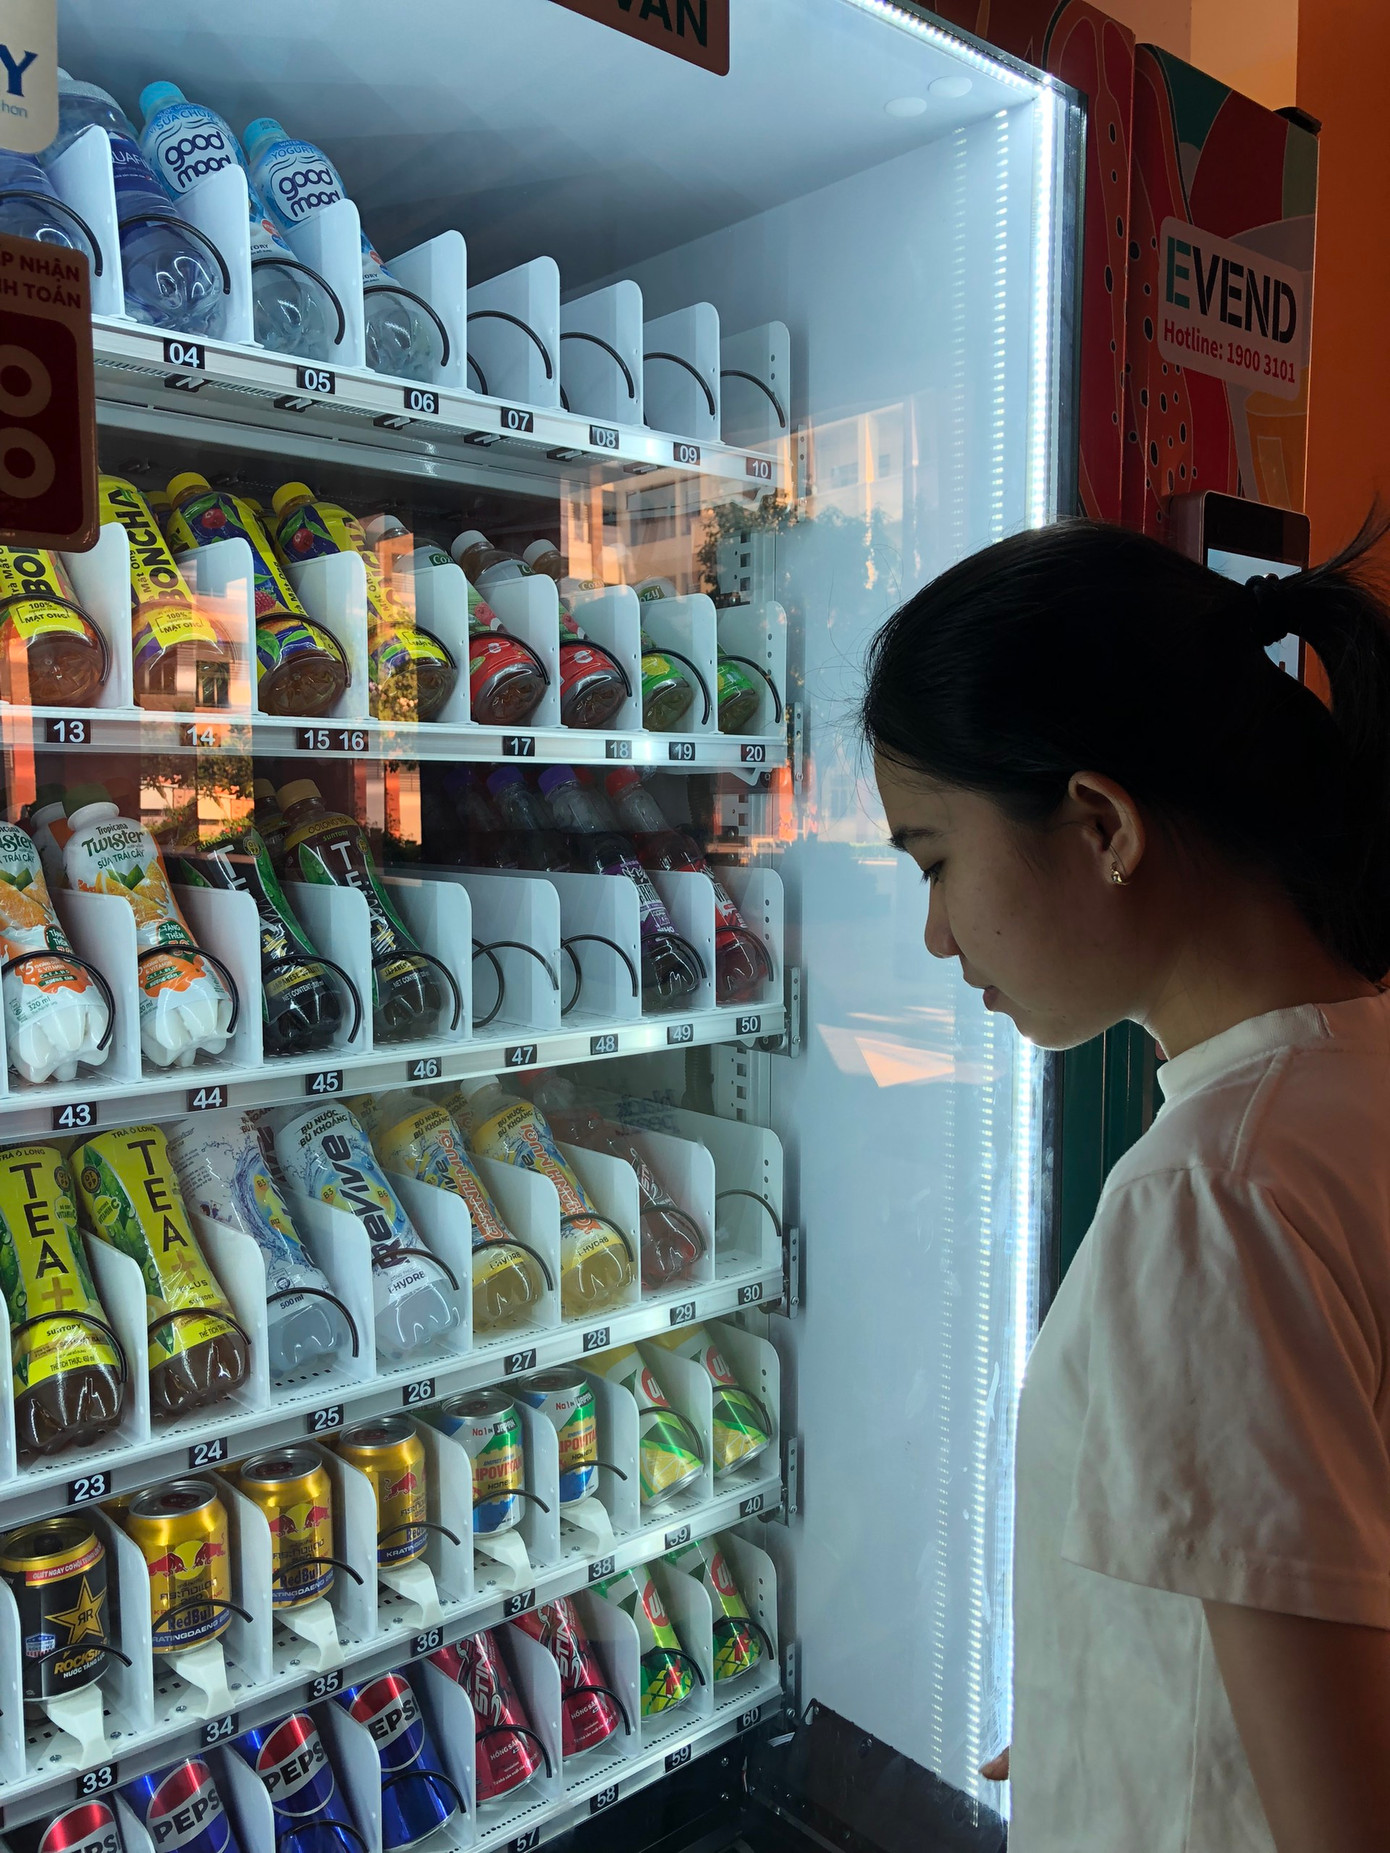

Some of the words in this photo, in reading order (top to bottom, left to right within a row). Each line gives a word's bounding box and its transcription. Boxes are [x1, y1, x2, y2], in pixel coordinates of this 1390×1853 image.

[165, 131, 225, 172] good
[272, 145, 315, 161] YOGURT
[278, 168, 333, 202] good
[1166, 235, 1297, 344] EVEND
[169, 342, 199, 368] 04
[1164, 318, 1224, 361] Hotline:
[1227, 342, 1260, 372] 1900
[1264, 354, 1296, 384] 3101
[305, 369, 330, 392] 05
[410, 391, 434, 413] 06
[508, 410, 530, 431] 07
[597, 430, 615, 447] 08
[680, 446, 697, 464] 09
[753, 461, 768, 477] 10
[28, 602, 52, 610] 100%
[166, 611, 188, 619] 100%
[54, 721, 85, 742] 13
[187, 726, 215, 746] 14
[305, 730, 330, 750] 15
[339, 731, 365, 751] 16
[511, 738, 532, 755] 17
[610, 741, 628, 758] 18
[675, 744, 692, 759] 19
[746, 746, 762, 761] 20
[96, 823, 129, 835] Tropicana
[25, 961, 34, 975] 5
[673, 1024, 691, 1041] 49
[741, 1016, 758, 1032] 50
[595, 1036, 615, 1053] 48
[511, 1047, 534, 1065] 47
[413, 1059, 437, 1078] 46
[312, 1072, 338, 1092] 45
[193, 1087, 222, 1108] 44
[59, 1105, 91, 1127] 43
[299, 1134, 313, 1147] BÙ
[314, 1114, 349, 1137] KHOÁNG
[301, 1121, 313, 1133] BÙ
[23, 1148, 46, 1157] LONG
[323, 1187, 334, 1200] B3
[377, 1189, 389, 1199] B6
[280, 1298, 295, 1310] 500
[295, 1294, 305, 1303] ml
[743, 1284, 760, 1301] 30
[676, 1303, 692, 1320] 29
[587, 1329, 606, 1348] 28
[512, 1351, 533, 1371] 27
[408, 1379, 431, 1402] 26
[314, 1405, 340, 1429] 25
[195, 1440, 222, 1465] 24
[74, 1475, 105, 1500] 23
[745, 1496, 761, 1514] 40
[670, 1527, 687, 1546] 39
[49, 1566, 64, 1577] NGAY
[593, 1558, 612, 1577] 38
[511, 1591, 532, 1612] 37
[417, 1629, 439, 1652] 36
[313, 1672, 339, 1696] 35
[743, 1707, 759, 1727] 60
[206, 1718, 234, 1742] 34
[672, 1746, 689, 1765] 59
[83, 1766, 113, 1793] 33
[597, 1786, 616, 1808] 58
[516, 1832, 536, 1851] 57
